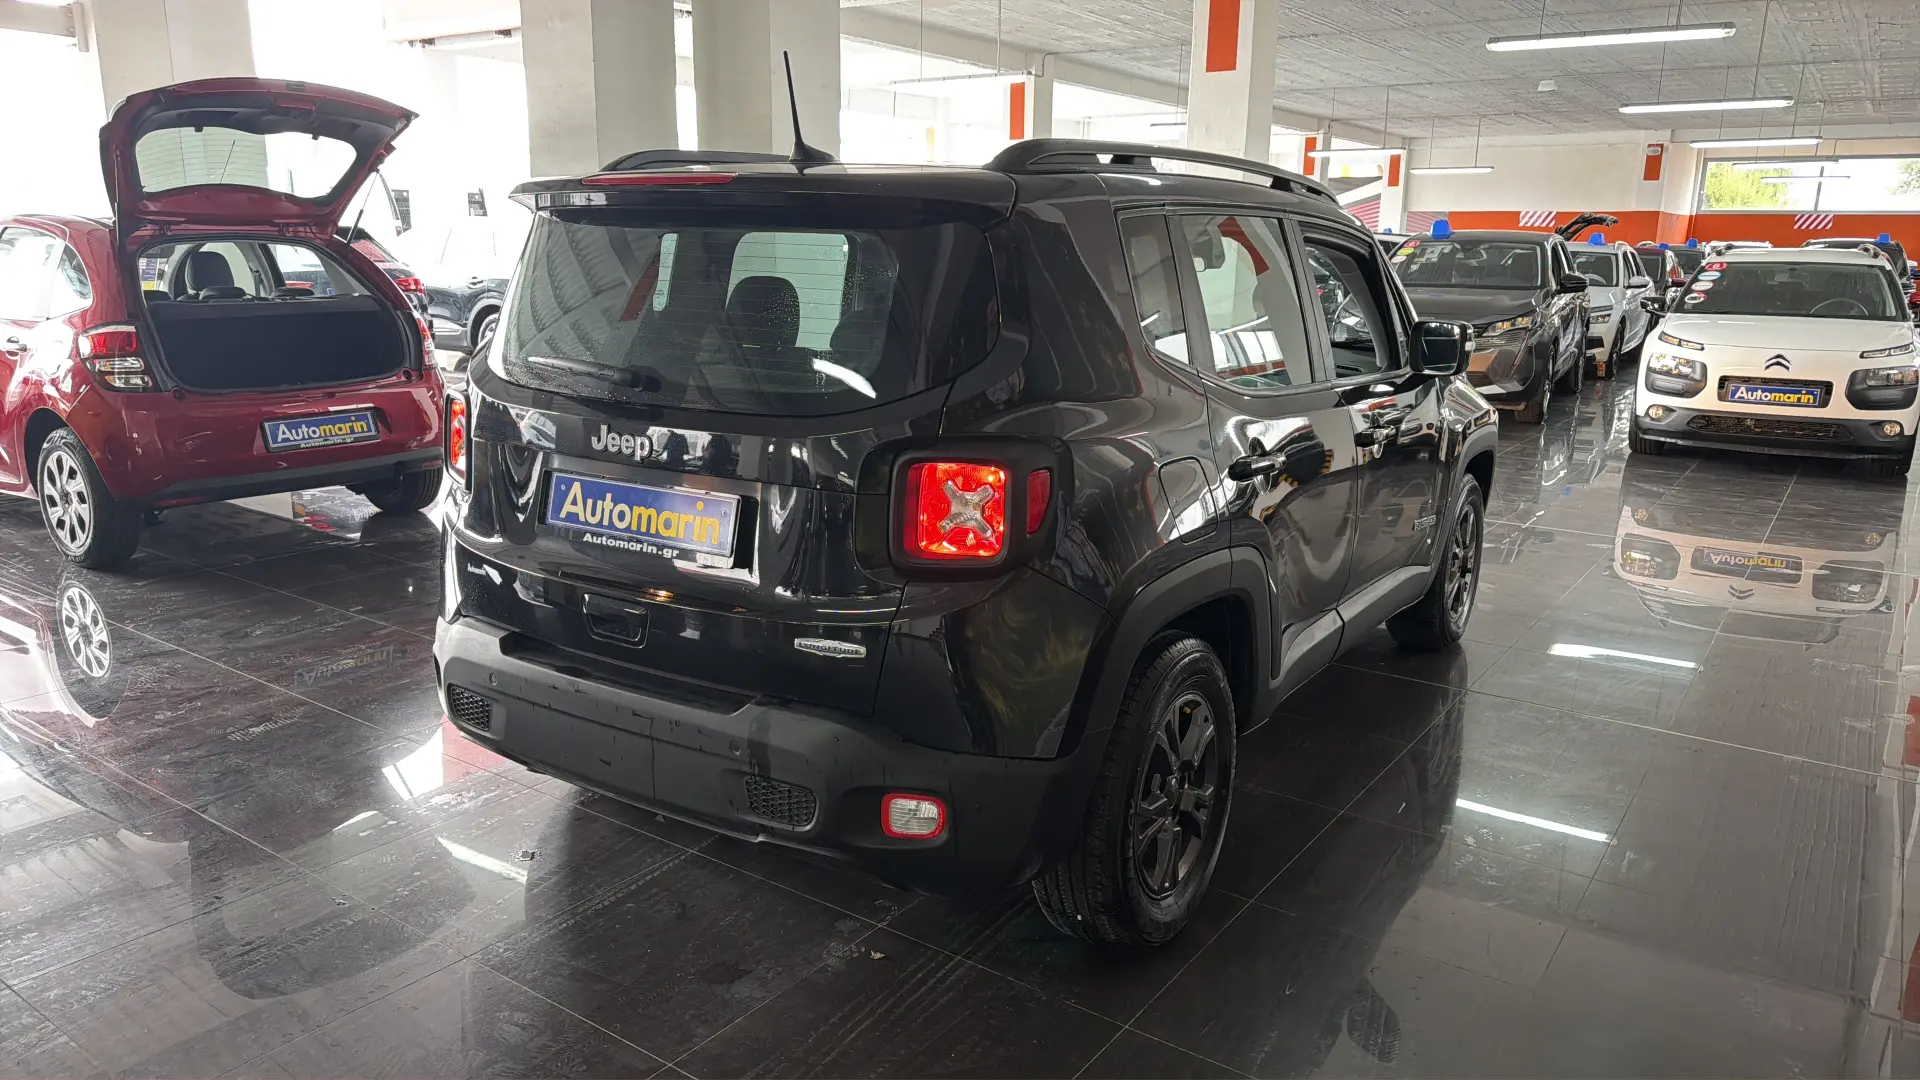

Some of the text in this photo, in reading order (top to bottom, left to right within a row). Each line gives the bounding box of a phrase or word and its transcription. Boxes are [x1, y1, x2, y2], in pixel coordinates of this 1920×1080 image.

[1734, 386, 1814, 404] Automarin
[277, 416, 369, 443] Automarin
[300, 437, 355, 449] Automarin.gr
[591, 423, 652, 463] Jeep
[559, 481, 721, 545] Automarin
[582, 532, 680, 558] Automarin.gr
